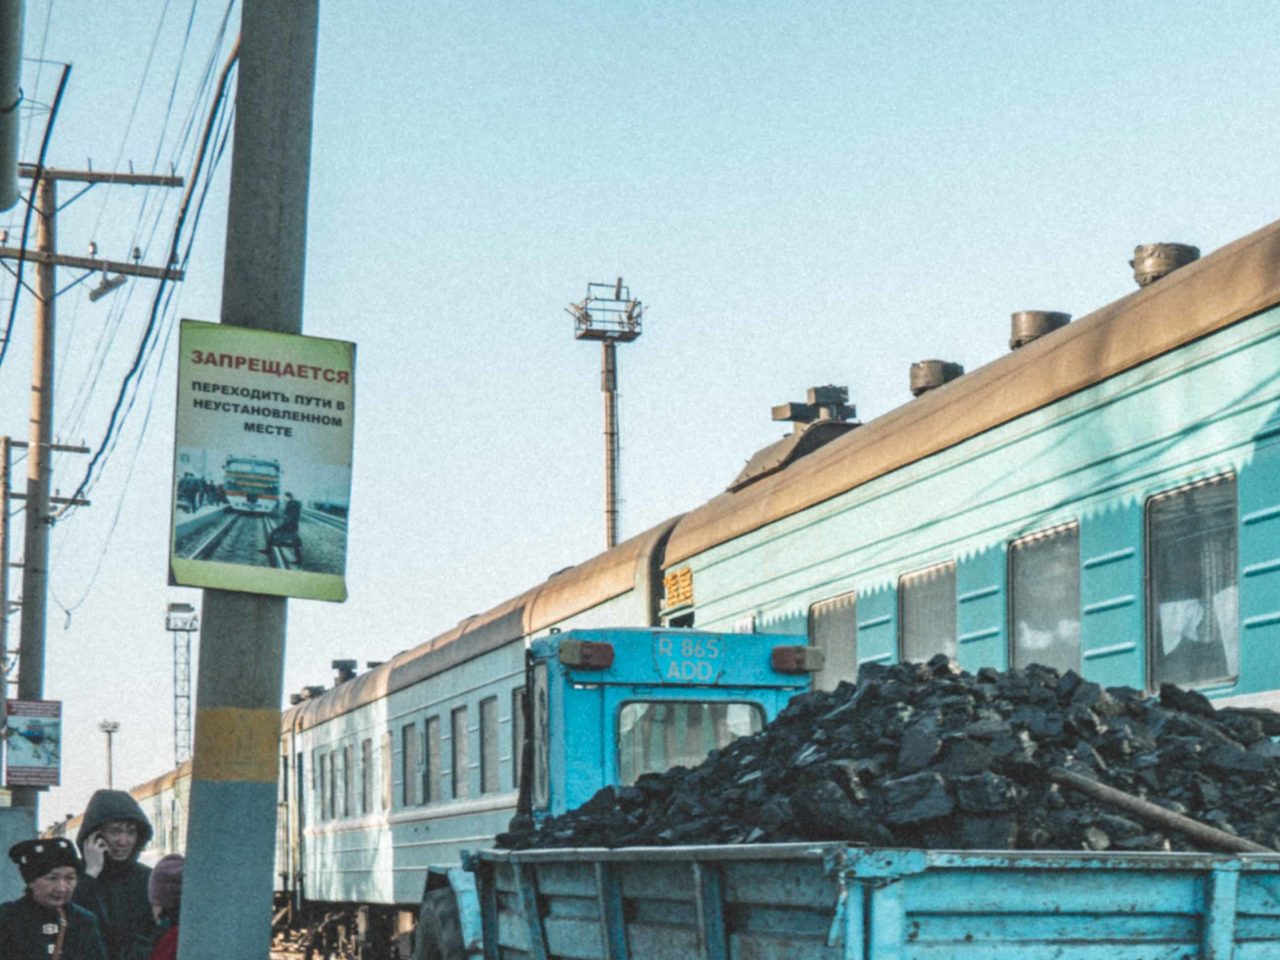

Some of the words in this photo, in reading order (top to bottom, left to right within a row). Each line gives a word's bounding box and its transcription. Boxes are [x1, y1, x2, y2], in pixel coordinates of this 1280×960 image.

[192, 350, 349, 385] ЗАПРЕЩАЕТСЯ
[191, 381, 290, 403] ПЕРЕХОДИТЬ
[294, 395, 332, 409] ПУТИ
[336, 401, 346, 411] В
[193, 399, 343, 427] НЕУСТАНОВЛЕННОМ
[243, 422, 293, 437] МЕСТЕ
[658, 638, 673, 657] R
[681, 638, 719, 658] 865
